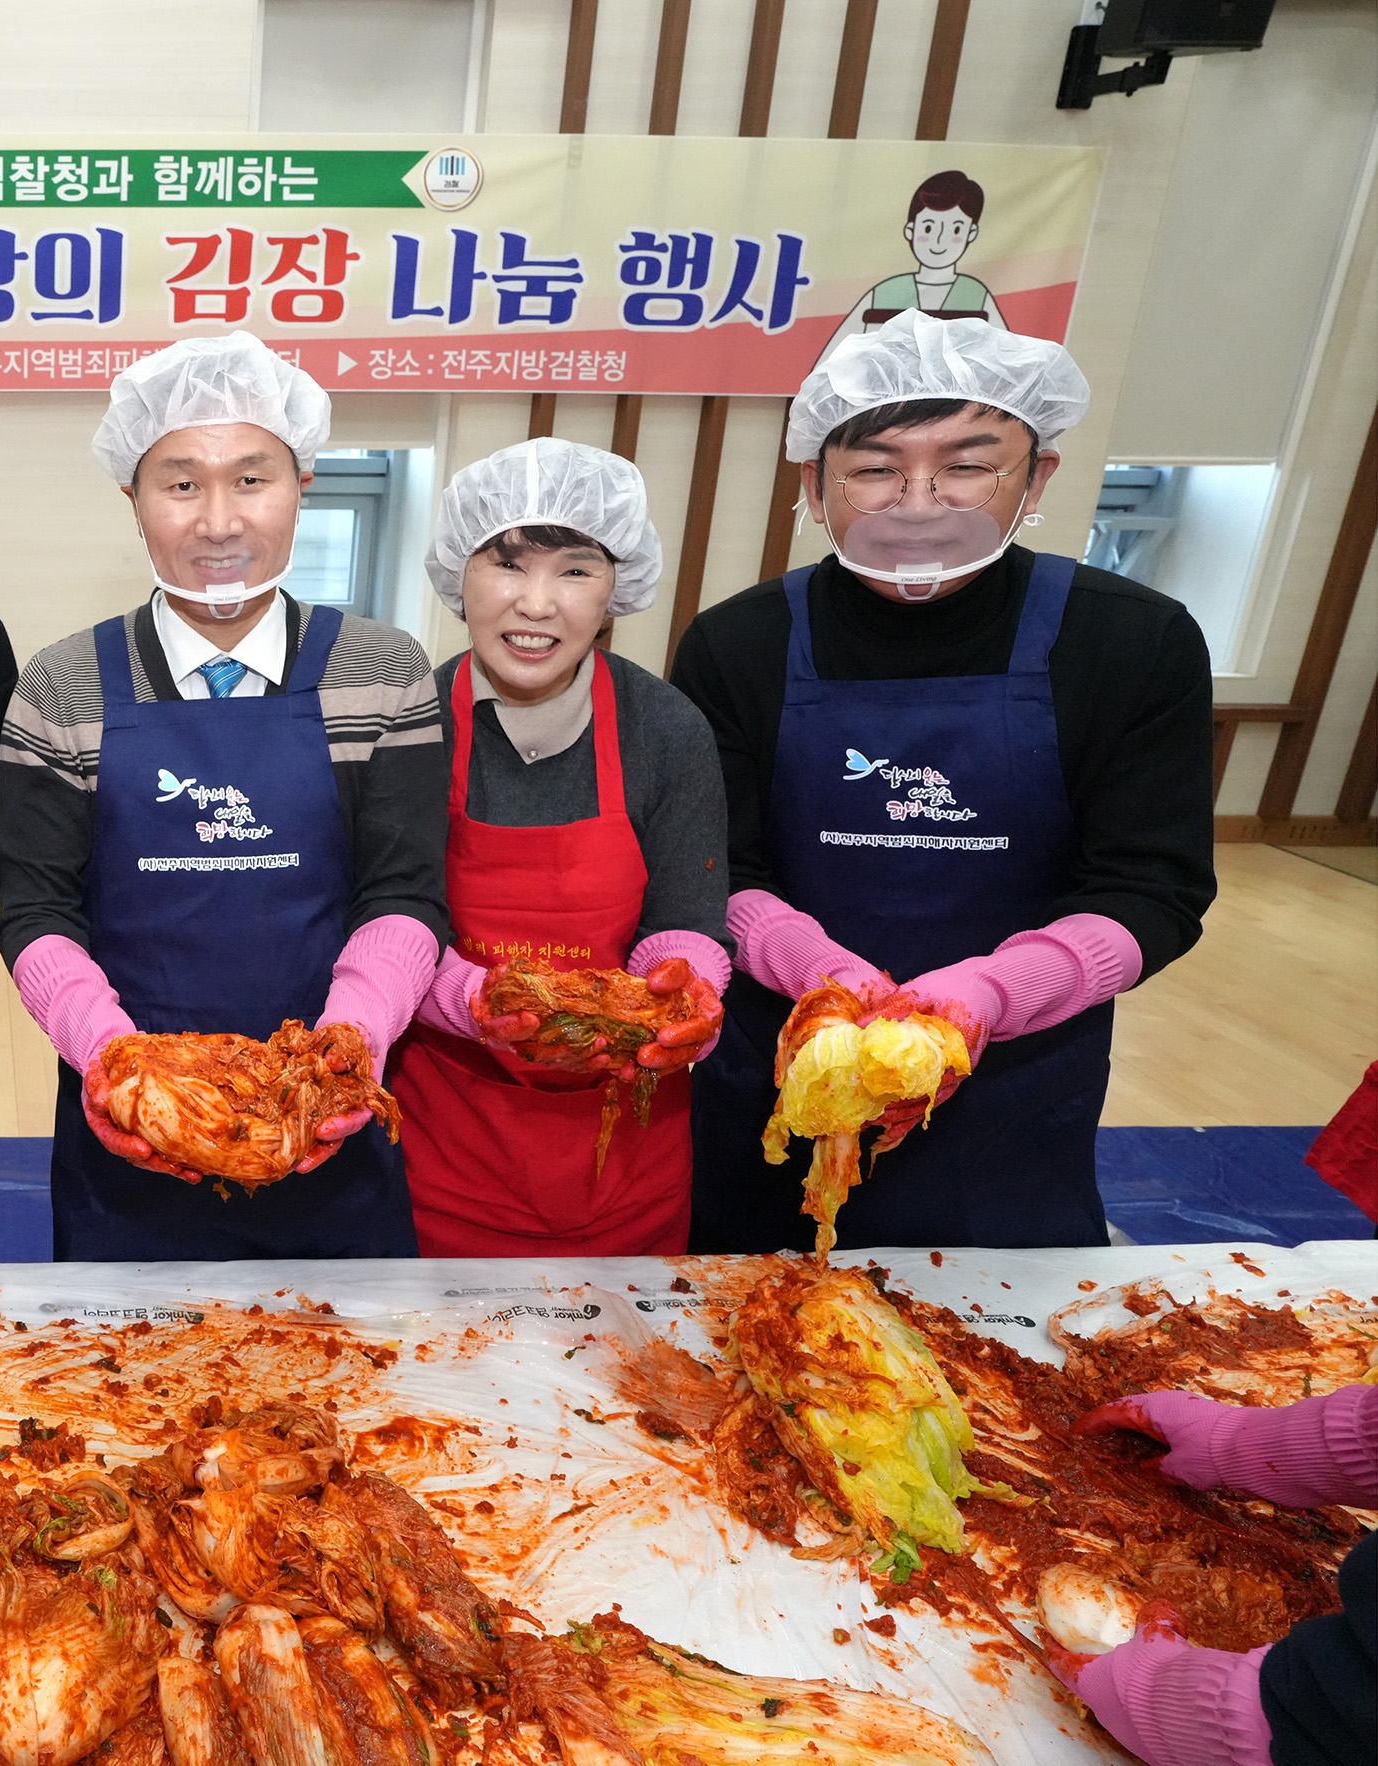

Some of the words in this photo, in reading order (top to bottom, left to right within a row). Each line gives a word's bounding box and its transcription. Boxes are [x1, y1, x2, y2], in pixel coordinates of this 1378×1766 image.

[153, 155, 319, 203] 함께하는
[165, 227, 360, 325] 김장
[390, 229, 584, 327] 나눔
[618, 231, 810, 331] 행사
